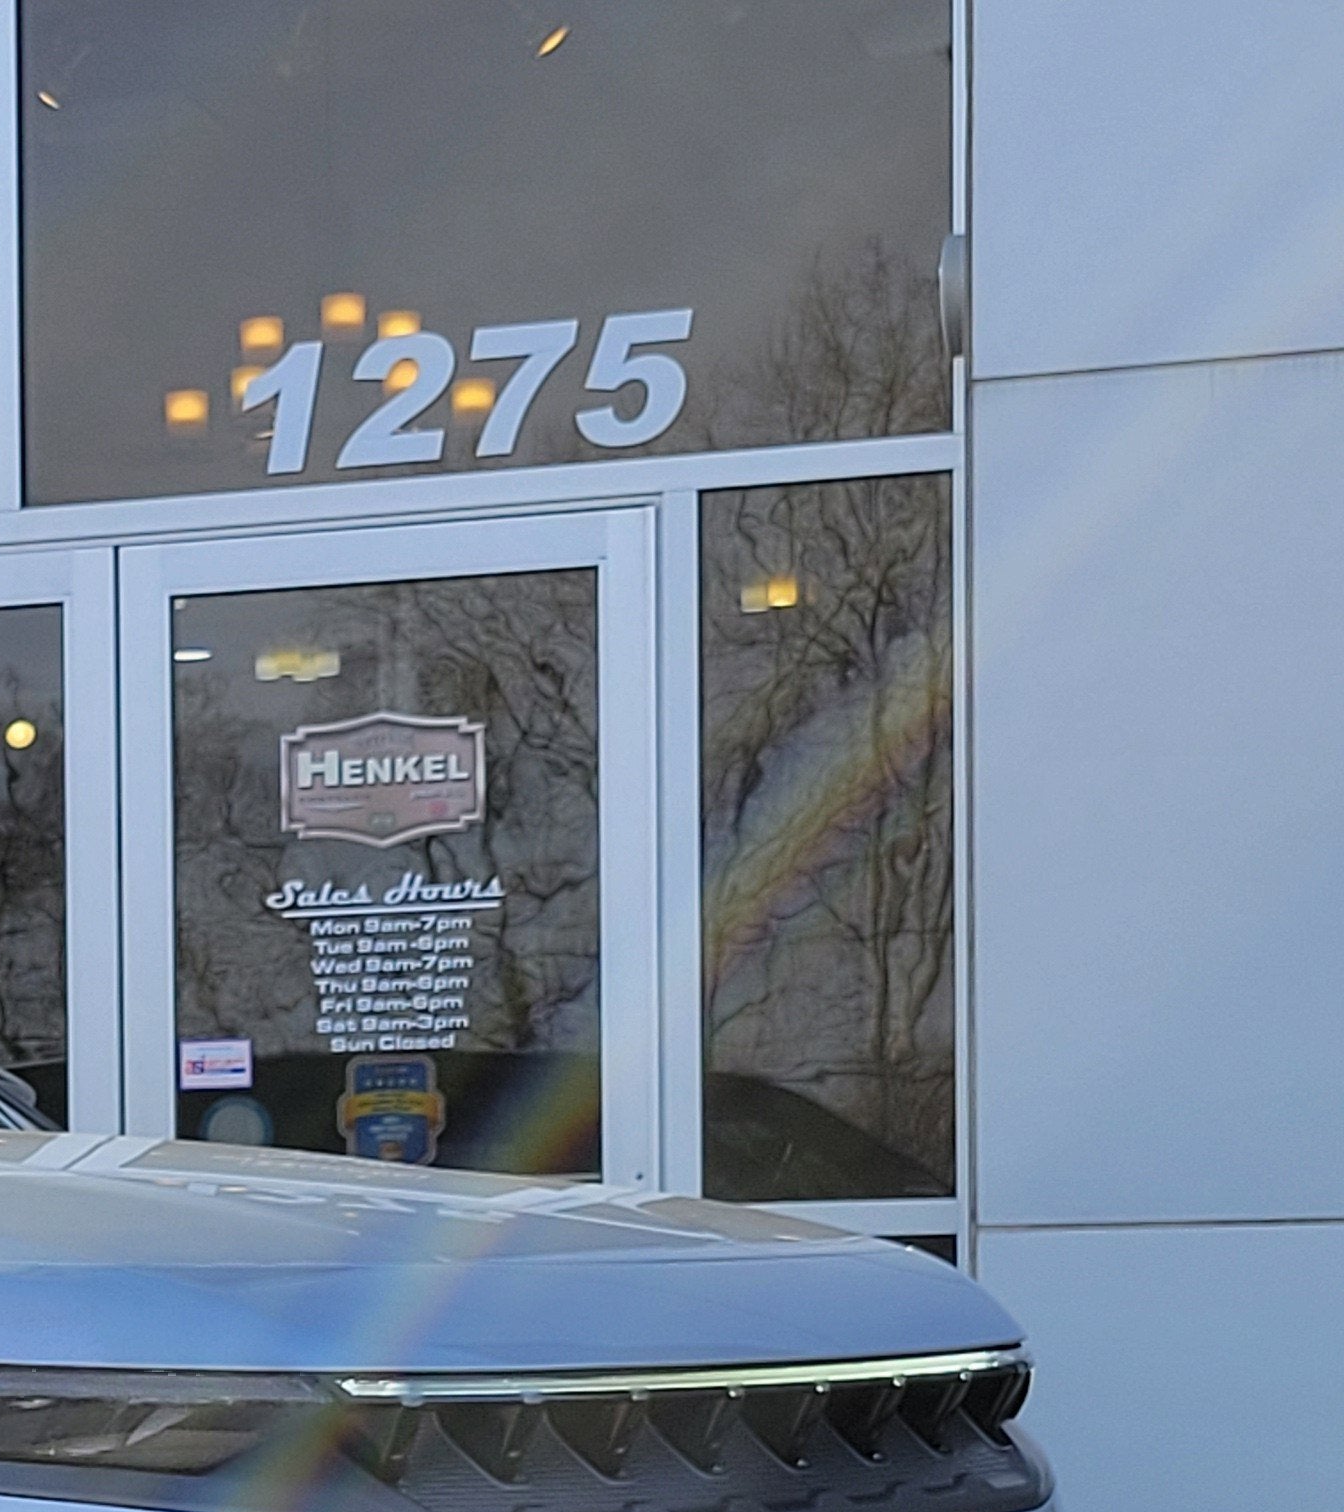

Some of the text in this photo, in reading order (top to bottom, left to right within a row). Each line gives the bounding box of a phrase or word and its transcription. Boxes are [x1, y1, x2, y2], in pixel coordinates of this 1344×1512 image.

[241, 308, 693, 475] 1275
[297, 750, 470, 789] HENKEL
[266, 871, 506, 909] Sales Hours
[311, 920, 360, 936] Mon
[313, 940, 354, 955] Tue
[311, 958, 361, 975] Wed
[314, 979, 357, 995] Thu
[320, 998, 352, 1014] Fri
[316, 1018, 357, 1034] Sat
[330, 1034, 456, 1053] Sun Closed
